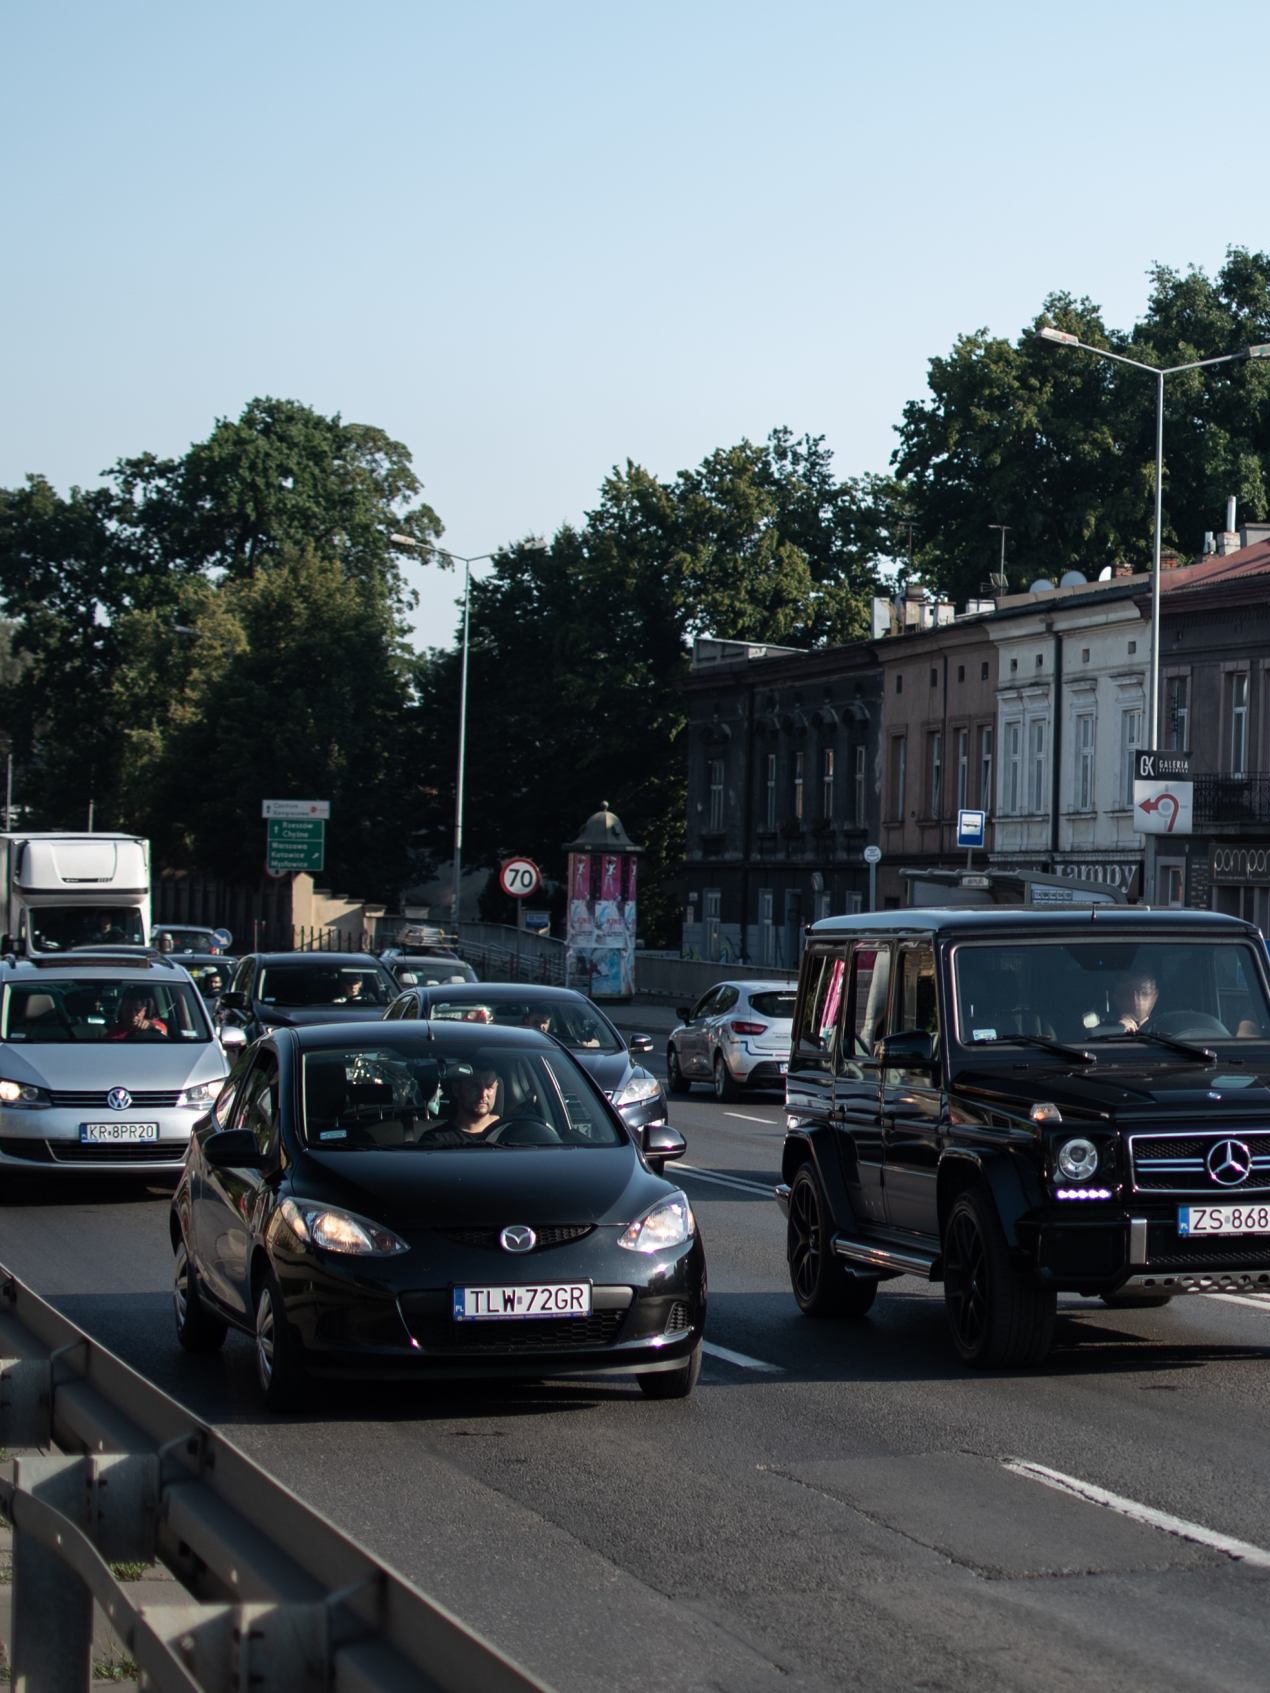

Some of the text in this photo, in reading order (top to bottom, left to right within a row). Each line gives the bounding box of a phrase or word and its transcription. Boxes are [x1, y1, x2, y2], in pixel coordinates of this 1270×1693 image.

[1140, 755, 1154, 776] GK
[1159, 760, 1189, 768] GALERIA
[282, 821, 313, 829] Rzeszów
[271, 842, 308, 850] Warszawa
[271, 851, 305, 859] Katowice
[509, 868, 533, 888] 70
[90, 1125, 154, 1139] KR 8PR20
[1193, 1209, 1223, 1230] ZS
[470, 1287, 584, 1313] TLW 72GR
